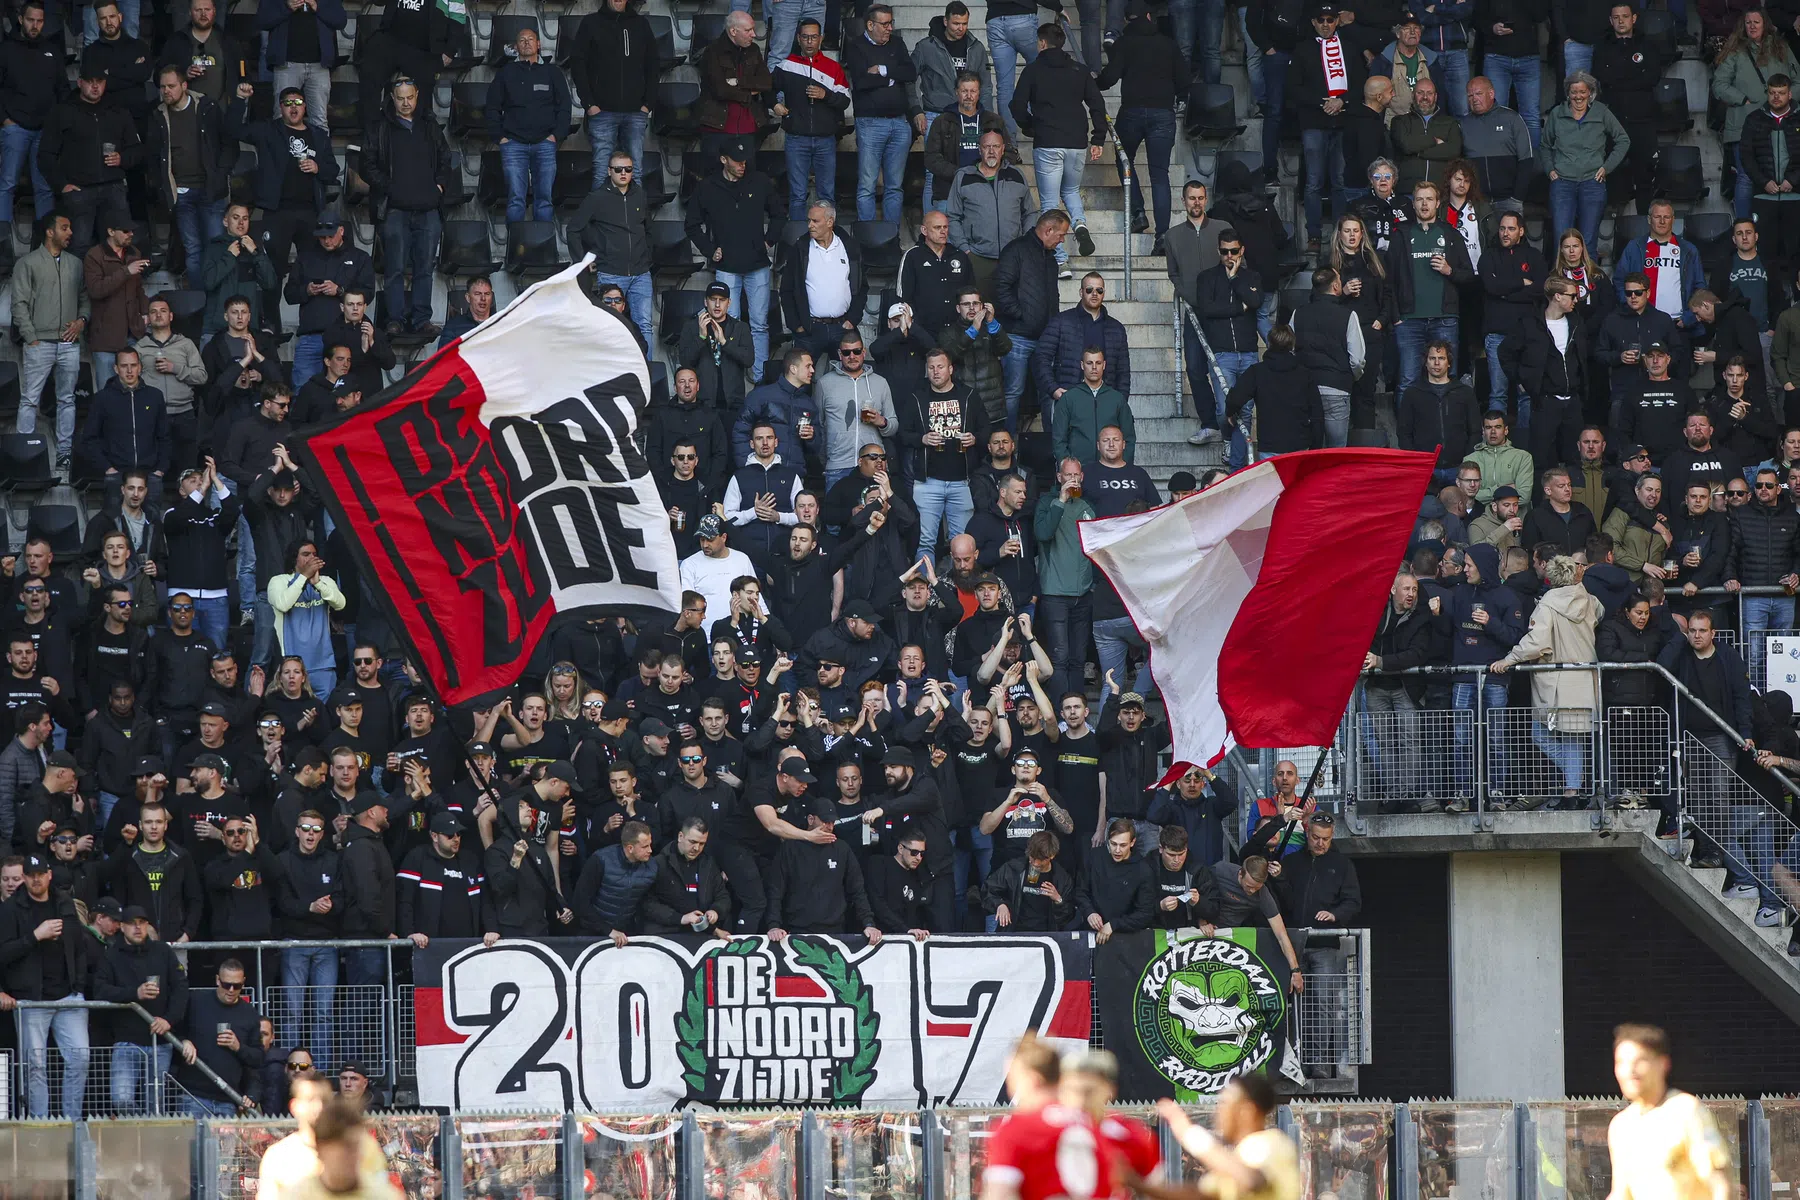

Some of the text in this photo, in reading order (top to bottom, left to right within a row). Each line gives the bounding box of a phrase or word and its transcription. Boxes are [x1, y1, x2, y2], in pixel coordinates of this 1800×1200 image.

[1644, 258, 1680, 269] ORTIS
[1100, 480, 1138, 489] BOSS
[718, 956, 768, 1006] DE
[1142, 940, 1278, 1000] ROTTERDAM
[718, 1007, 854, 1058] NOORD
[716, 1058, 832, 1103] ZIJDE
